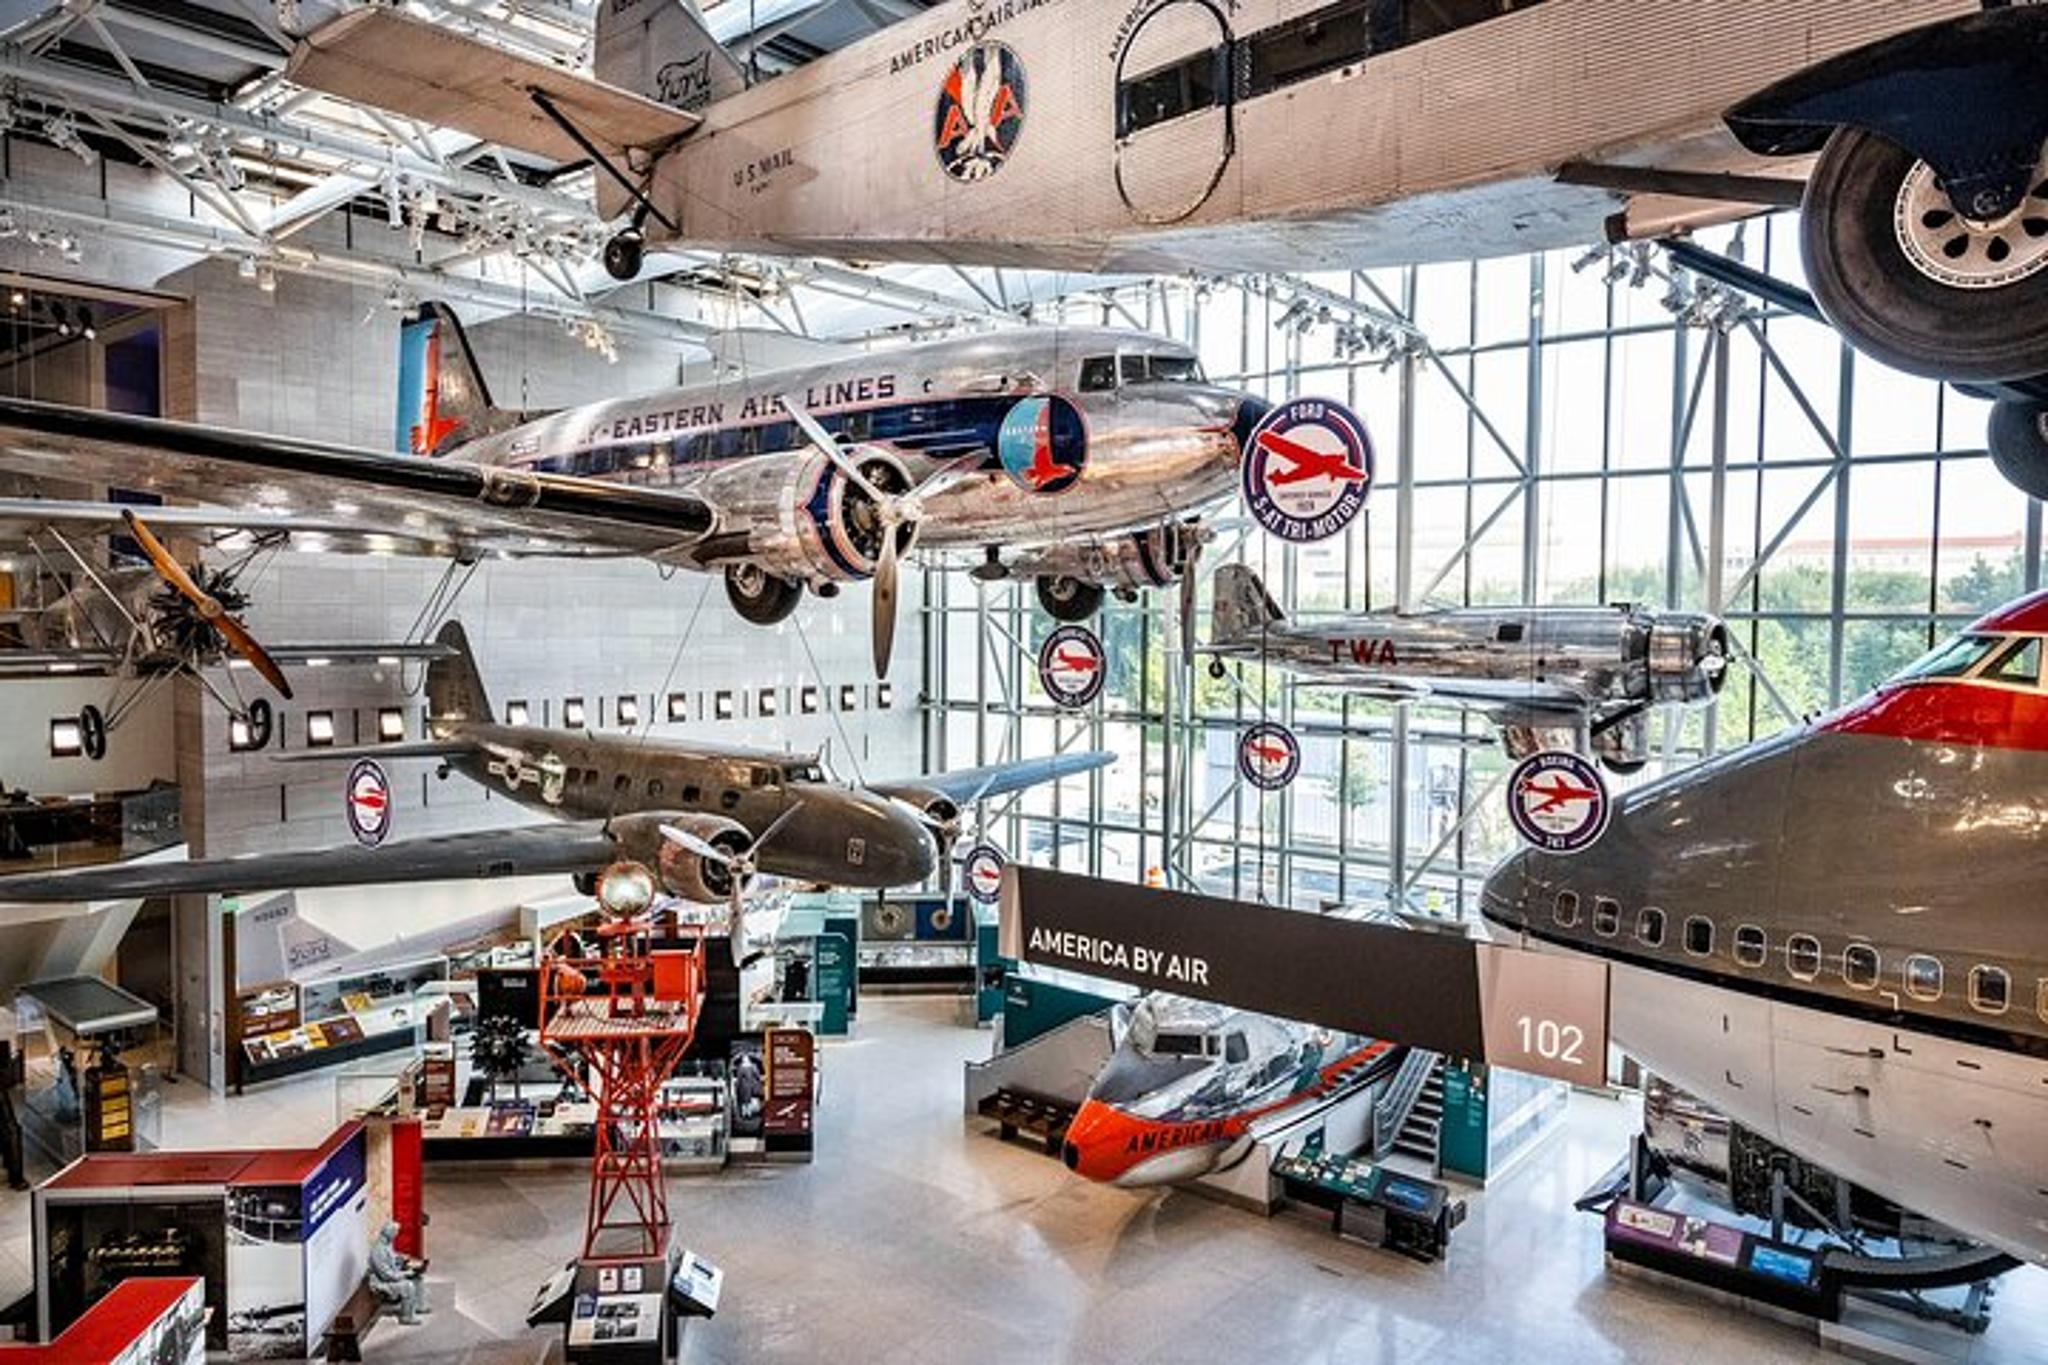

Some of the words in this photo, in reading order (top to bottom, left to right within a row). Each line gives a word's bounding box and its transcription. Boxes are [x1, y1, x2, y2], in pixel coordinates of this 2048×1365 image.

[656, 50, 712, 102] Ford
[740, 394, 787, 419] AIR
[806, 374, 895, 410] LINES
[1327, 638, 1397, 665] TWA
[1029, 926, 1129, 969] AMERICA
[1133, 946, 1164, 976] BY
[1166, 954, 1209, 986] AIR
[1517, 1016, 1584, 1065] 102
